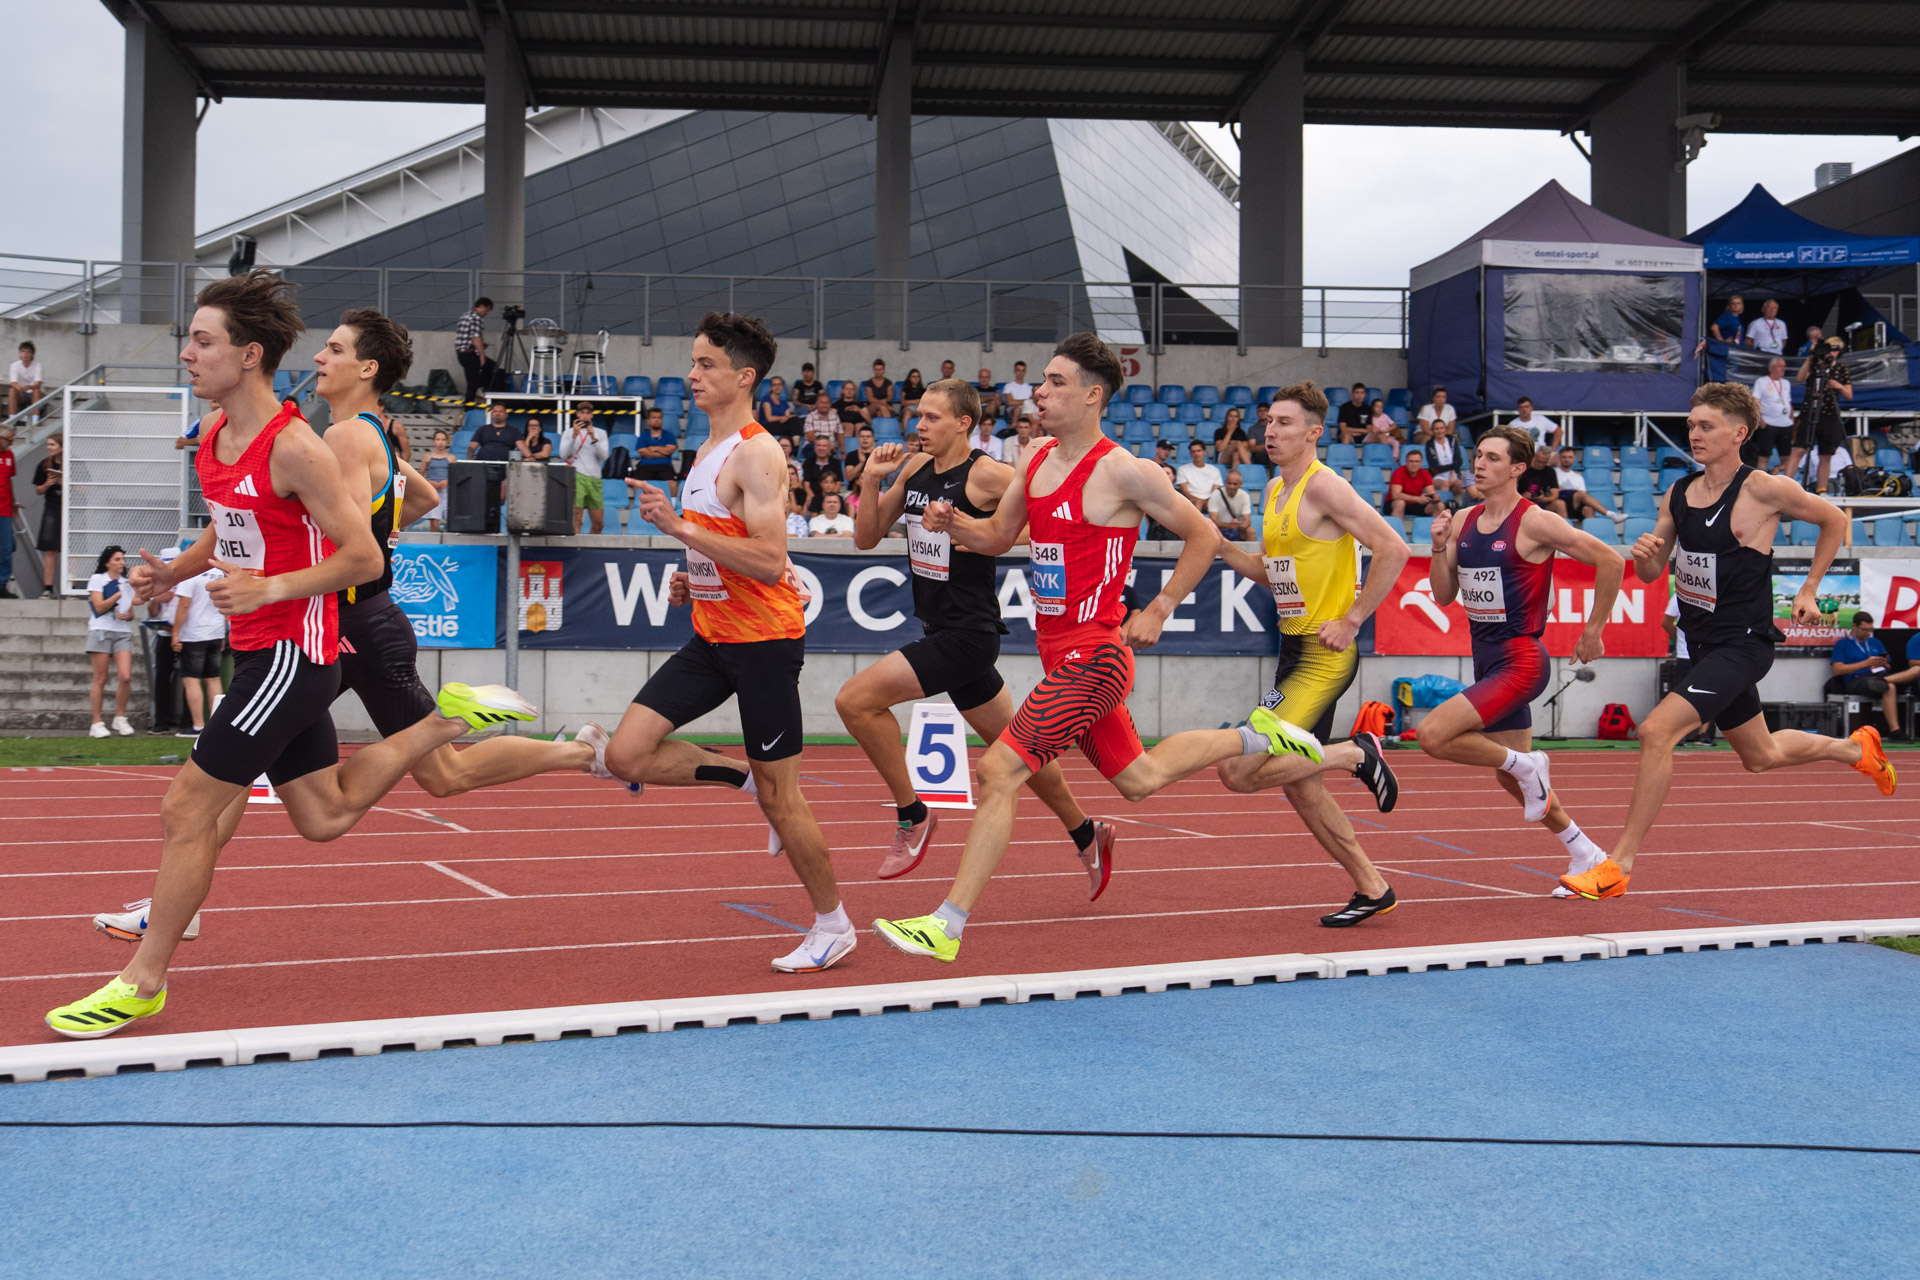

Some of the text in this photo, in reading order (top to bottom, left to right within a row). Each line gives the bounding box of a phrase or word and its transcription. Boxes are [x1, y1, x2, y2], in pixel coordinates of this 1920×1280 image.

[1534, 249, 1599, 259] domtel-sport.pl
[1120, 347, 1141, 378] 5
[225, 511, 245, 527] 10
[217, 537, 251, 558] SIEL
[911, 539, 942, 558] ŁYSIAK
[1035, 546, 1058, 561] 548
[1273, 560, 1290, 572] 737
[1686, 554, 1710, 569] 541
[1473, 570, 1496, 582] 492
[1783, 627, 1852, 638] ZAPRASZAMY
[1851, 703, 1858, 711] 4
[916, 723, 956, 784] 5
